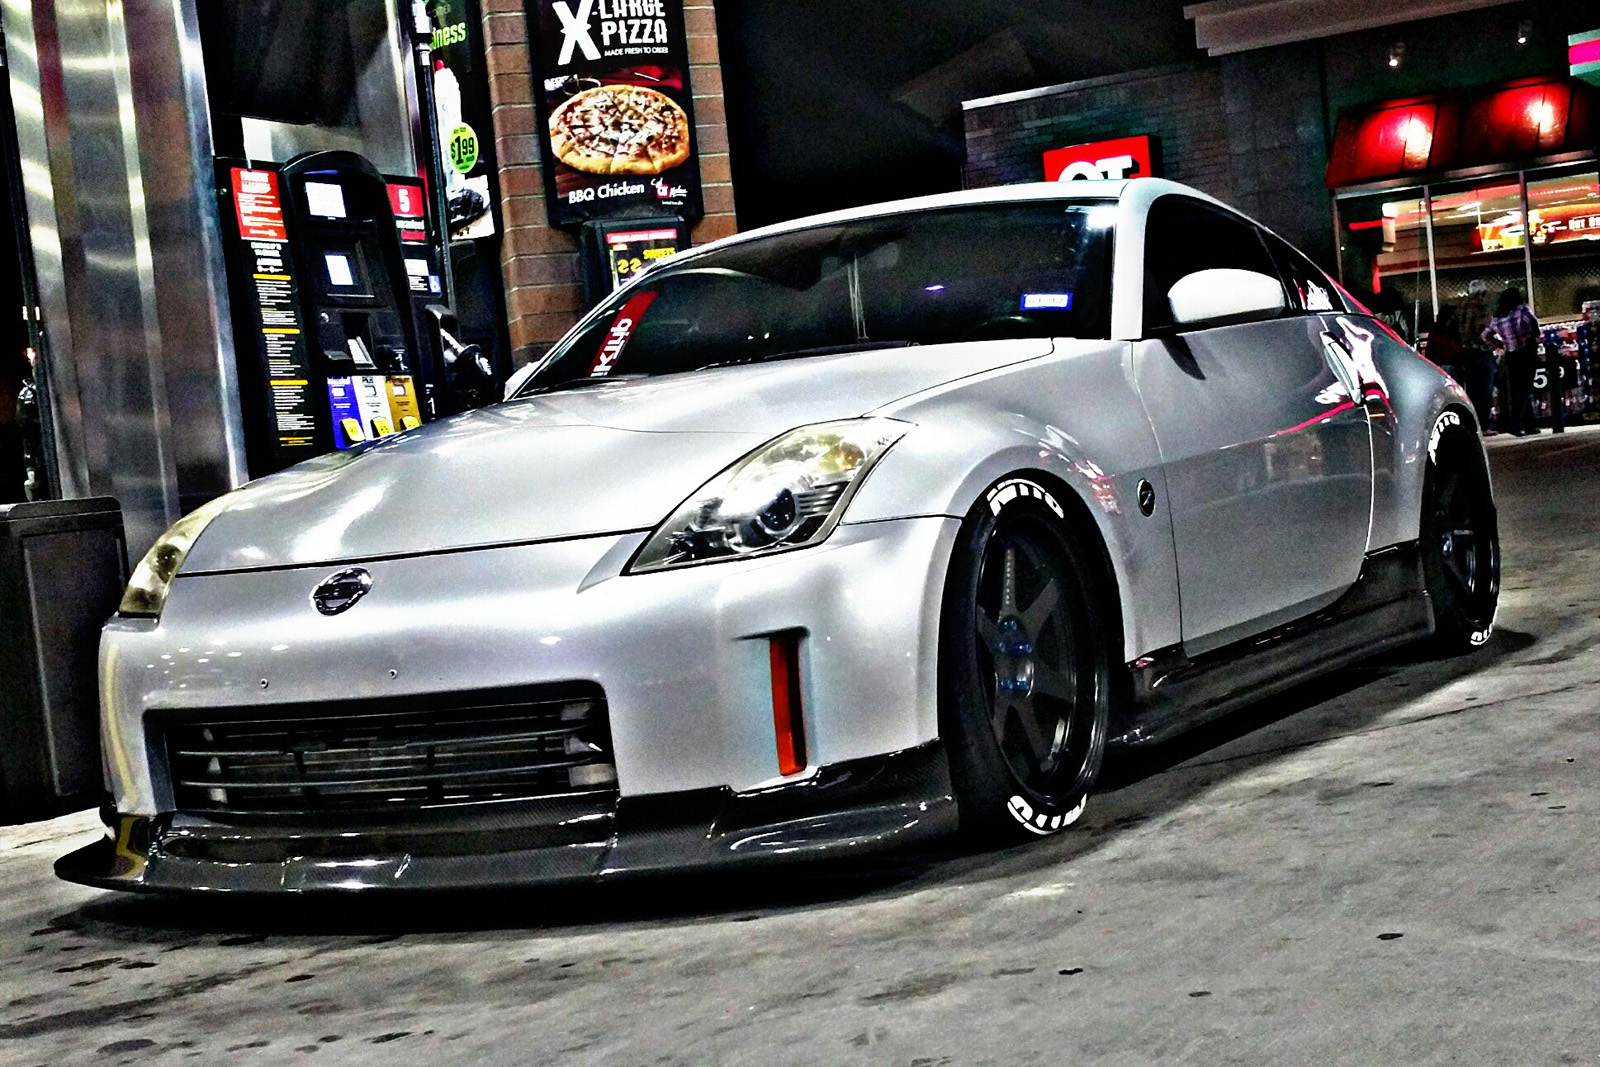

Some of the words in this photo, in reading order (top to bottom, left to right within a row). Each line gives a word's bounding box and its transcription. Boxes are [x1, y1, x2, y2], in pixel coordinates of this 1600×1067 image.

[600, 19, 668, 46] PIZZA
[398, 188, 411, 213] 5
[568, 187, 595, 204] BBQ
[597, 181, 645, 199] Chicken
[1533, 368, 1548, 389] 5
[986, 478, 1065, 519] NITTO
